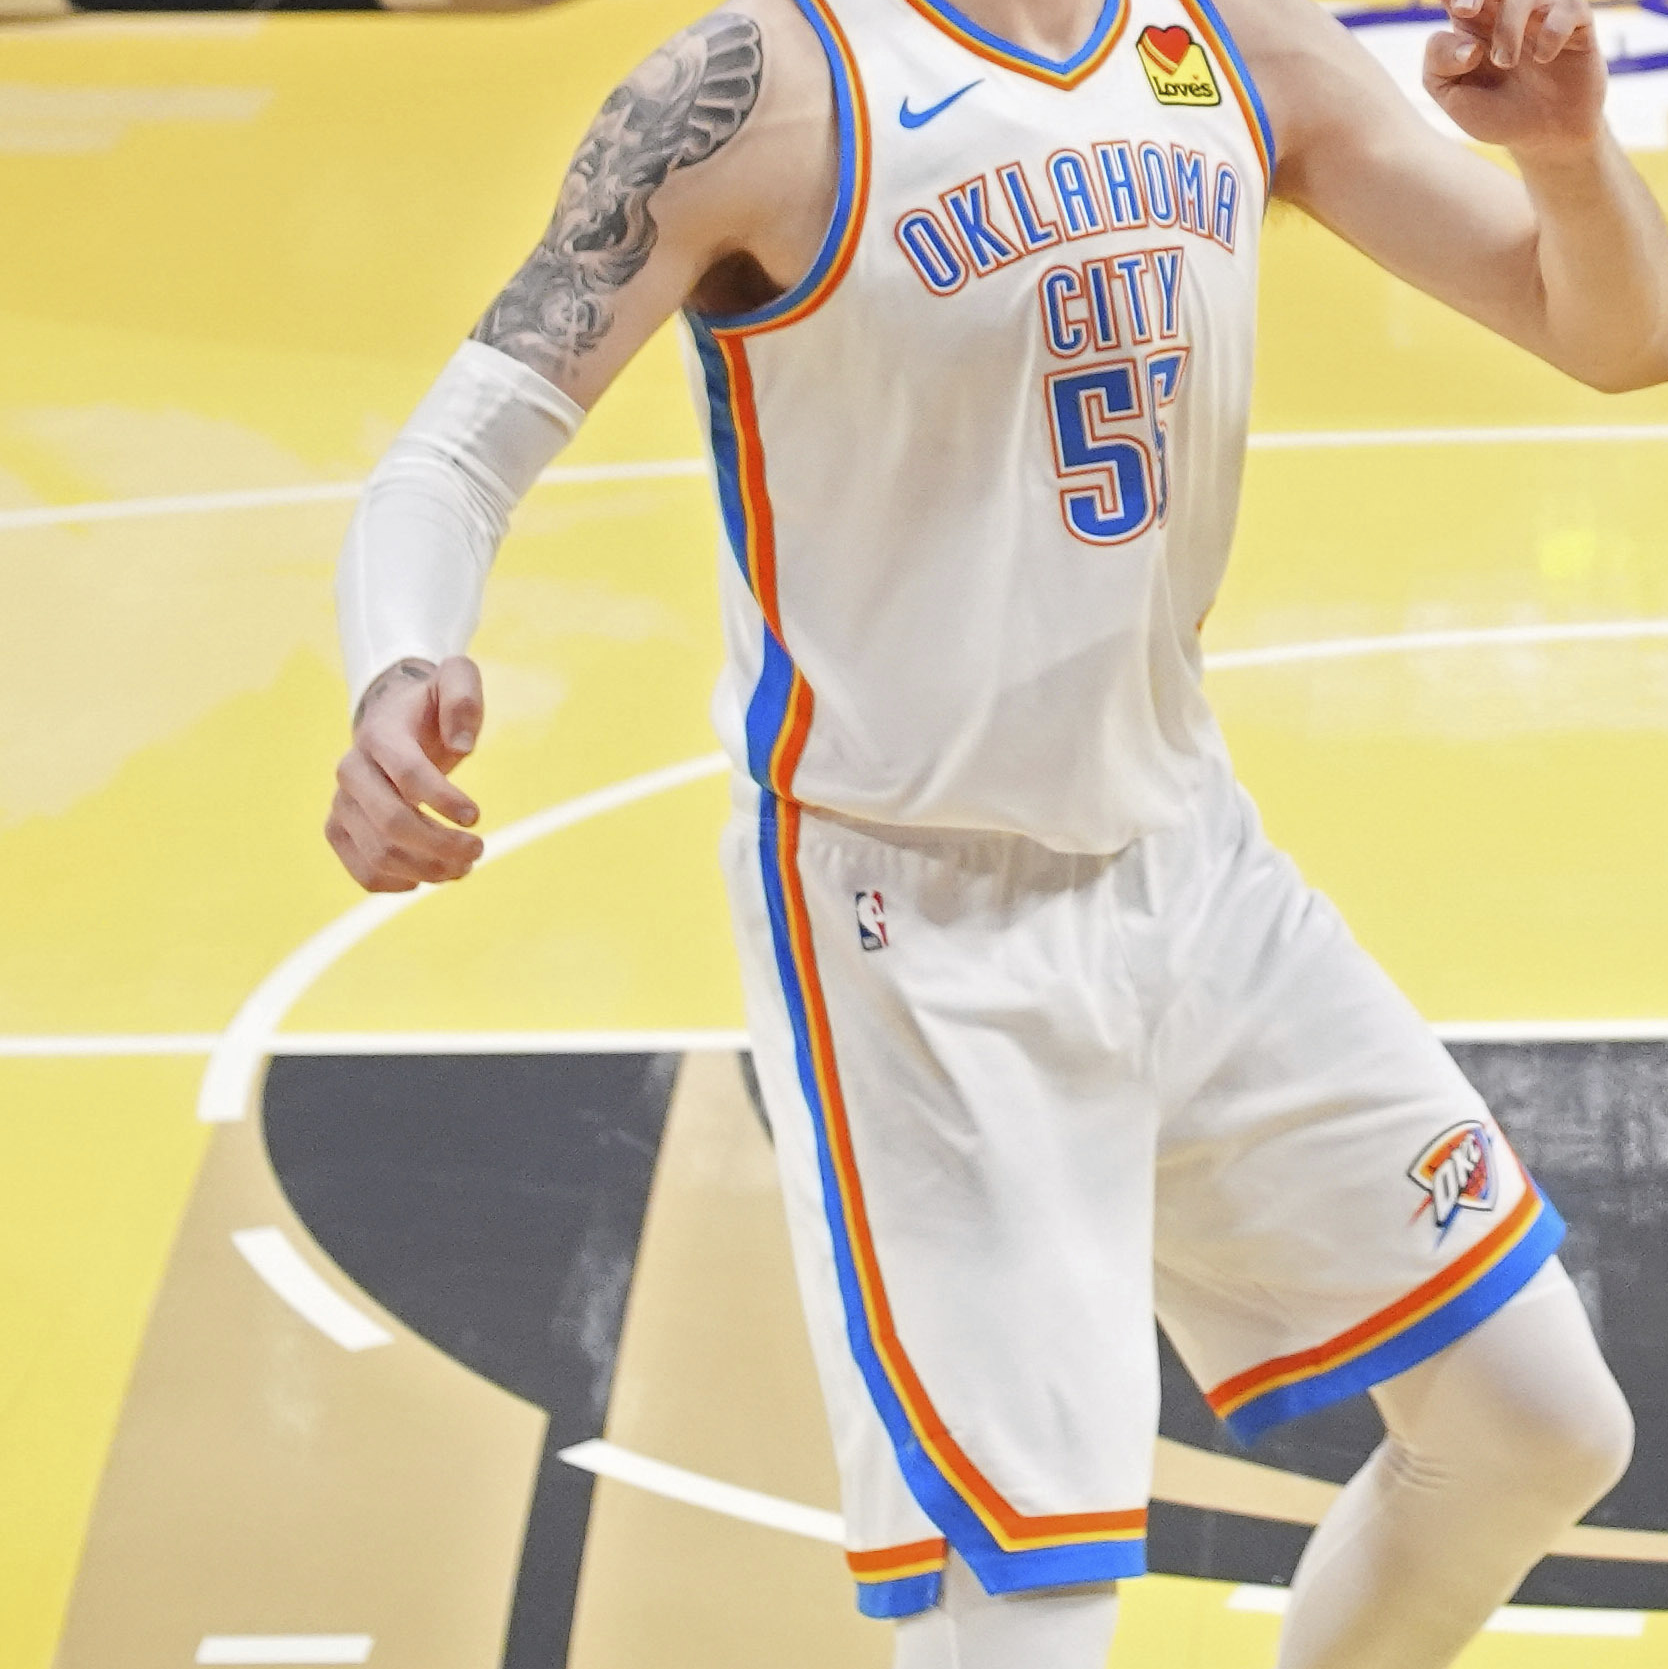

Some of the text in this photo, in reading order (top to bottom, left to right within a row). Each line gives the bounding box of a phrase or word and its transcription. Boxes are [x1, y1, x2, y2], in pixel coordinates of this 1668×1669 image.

[1154, 75, 1213, 100] Love's
[894, 139, 1241, 298] OKLAHOMA
[1038, 246, 1185, 359] CITY
